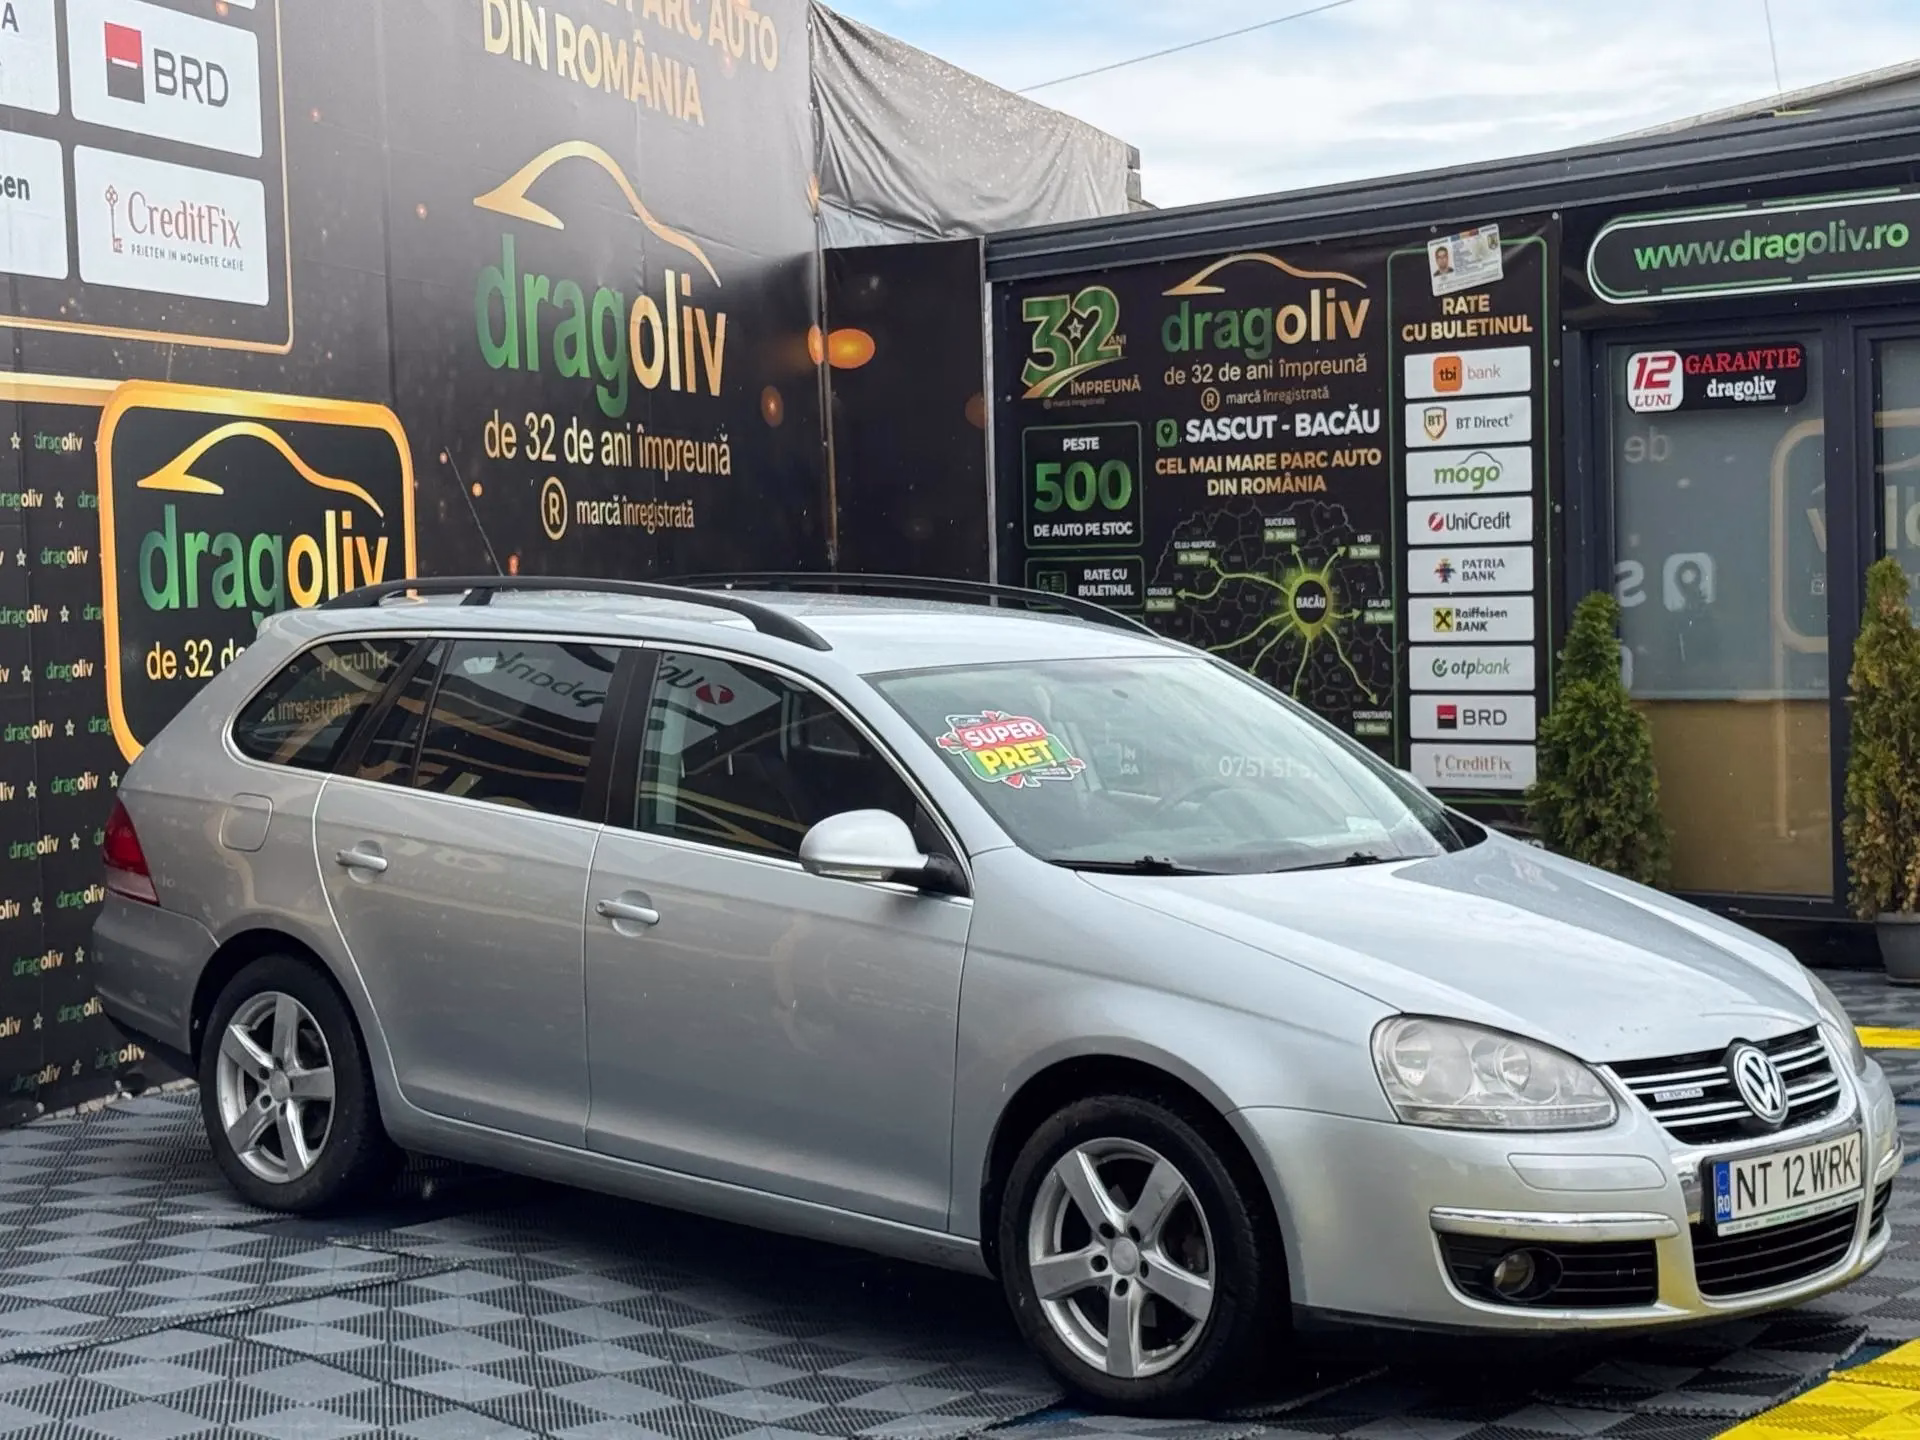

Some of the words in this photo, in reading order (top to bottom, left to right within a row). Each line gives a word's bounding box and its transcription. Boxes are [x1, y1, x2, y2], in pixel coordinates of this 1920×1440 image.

[708, 0, 779, 72] AUTO
[482, 0, 548, 71] DIN
[554, 12, 705, 127] ROMÂNIA
[153, 48, 229, 107] BRD
[128, 191, 242, 249] CreditFix
[1633, 219, 1910, 271] www.dragoliv.ro
[1442, 294, 1491, 315] RATE
[475, 233, 728, 418] dragoliv
[1161, 287, 1371, 360] dragoliv
[1402, 323, 1428, 341] CU
[1431, 314, 1533, 340] BULETINUL
[1021, 285, 1122, 388] 32
[1164, 366, 1186, 386] de
[1191, 363, 1214, 384] 32
[1218, 361, 1242, 382] de
[1246, 359, 1274, 380] ani
[1278, 352, 1368, 382] împreună
[1439, 366, 1457, 382] tbi
[1467, 364, 1501, 380] bank
[1633, 356, 1677, 390] 12
[1685, 348, 1801, 375] GARANTIE
[1225, 390, 1261, 405] marcă
[1706, 374, 1777, 402] dragoliv
[1634, 394, 1672, 408] LUNI
[1185, 415, 1279, 444] SASCUT
[1295, 404, 1381, 438] BACĂU
[1456, 416, 1472, 430] BT
[34, 431, 83, 454] dragoliv
[484, 409, 518, 460] de
[524, 411, 557, 463] 32
[563, 416, 595, 466] de
[600, 422, 633, 468] ani
[637, 423, 732, 482] împreună
[1063, 437, 1100, 451] PESTE
[1155, 458, 1187, 475] CEL
[1189, 457, 1222, 473] MAI
[1226, 453, 1277, 473] MARE
[1280, 452, 1328, 470] PARC
[1332, 448, 1382, 467] AUTO
[1033, 460, 1132, 513] 500
[1207, 477, 1238, 496] DIN
[1241, 472, 1327, 494] ROMÂNIA
[1434, 466, 1500, 491] mogo
[0, 488, 43, 512] ragoliv
[576, 495, 622, 526] marcă
[623, 499, 696, 535] înregistrată
[1446, 511, 1512, 531] UniCredit
[1033, 525, 1050, 537] DE
[1052, 523, 1083, 536] AUTO
[1085, 523, 1100, 536] PE
[1102, 521, 1133, 535] STOC
[40, 546, 88, 569] dragoliv
[139, 503, 389, 632] dragoliv
[1462, 558, 1505, 569] PATRIA
[1083, 569, 1110, 581] RATE
[1112, 568, 1128, 580] CU
[1462, 571, 1496, 581] BANK
[1078, 584, 1134, 597] BULETINUL
[1296, 594, 1326, 609] BACĂU
[1455, 607, 1508, 619] Raiffeisen
[1455, 622, 1488, 632] BANK
[46, 659, 94, 682] dragoliv
[146, 641, 177, 680] de
[184, 639, 214, 678] 32
[1451, 659, 1511, 678] otpbank
[1463, 710, 1508, 725] BRD
[4, 720, 54, 744] dragoliv
[964, 721, 1041, 747] SUPER
[1445, 754, 1512, 772] CreditFix
[51, 771, 99, 796] dragoliv
[8, 834, 59, 860] dragoliv
[56, 884, 105, 910] dragoliv
[12, 950, 64, 976] dragoliv
[1735, 1161, 1773, 1211] NT
[1783, 1155, 1806, 1199] 12
[1809, 1139, 1856, 1193] WRK
[1717, 1195, 1731, 1214] RO
